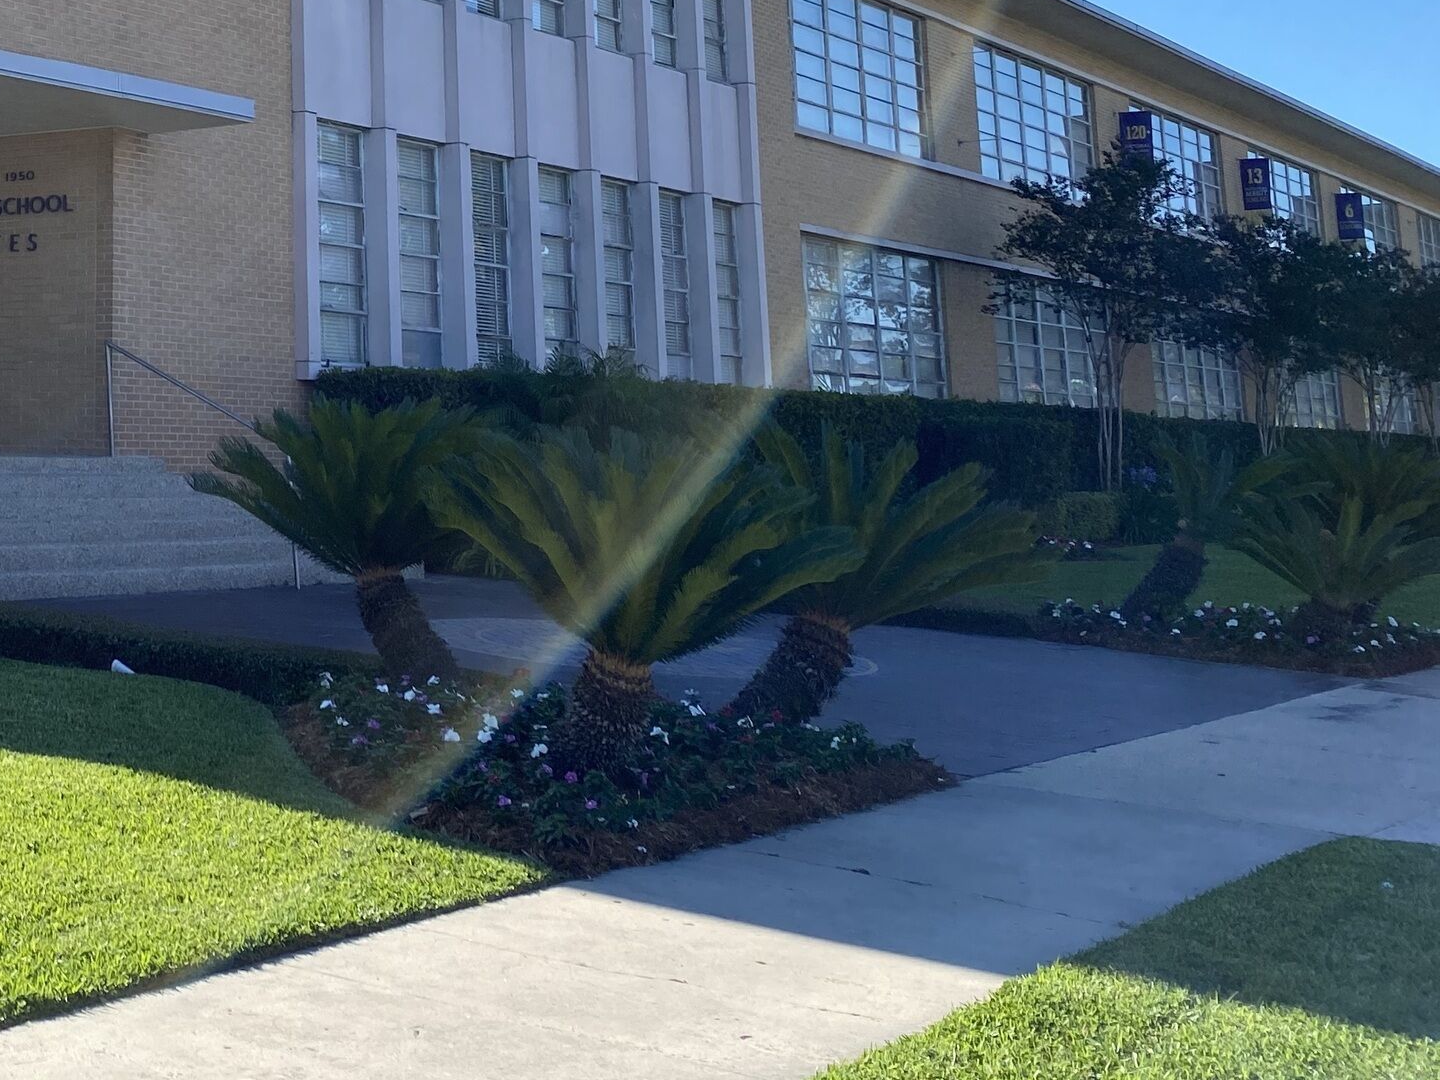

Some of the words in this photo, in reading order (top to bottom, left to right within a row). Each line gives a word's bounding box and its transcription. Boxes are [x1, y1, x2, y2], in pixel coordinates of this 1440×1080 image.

[5, 171, 35, 182] 1950
[1246, 168, 1263, 184] 13
[1345, 203, 1354, 218] 6
